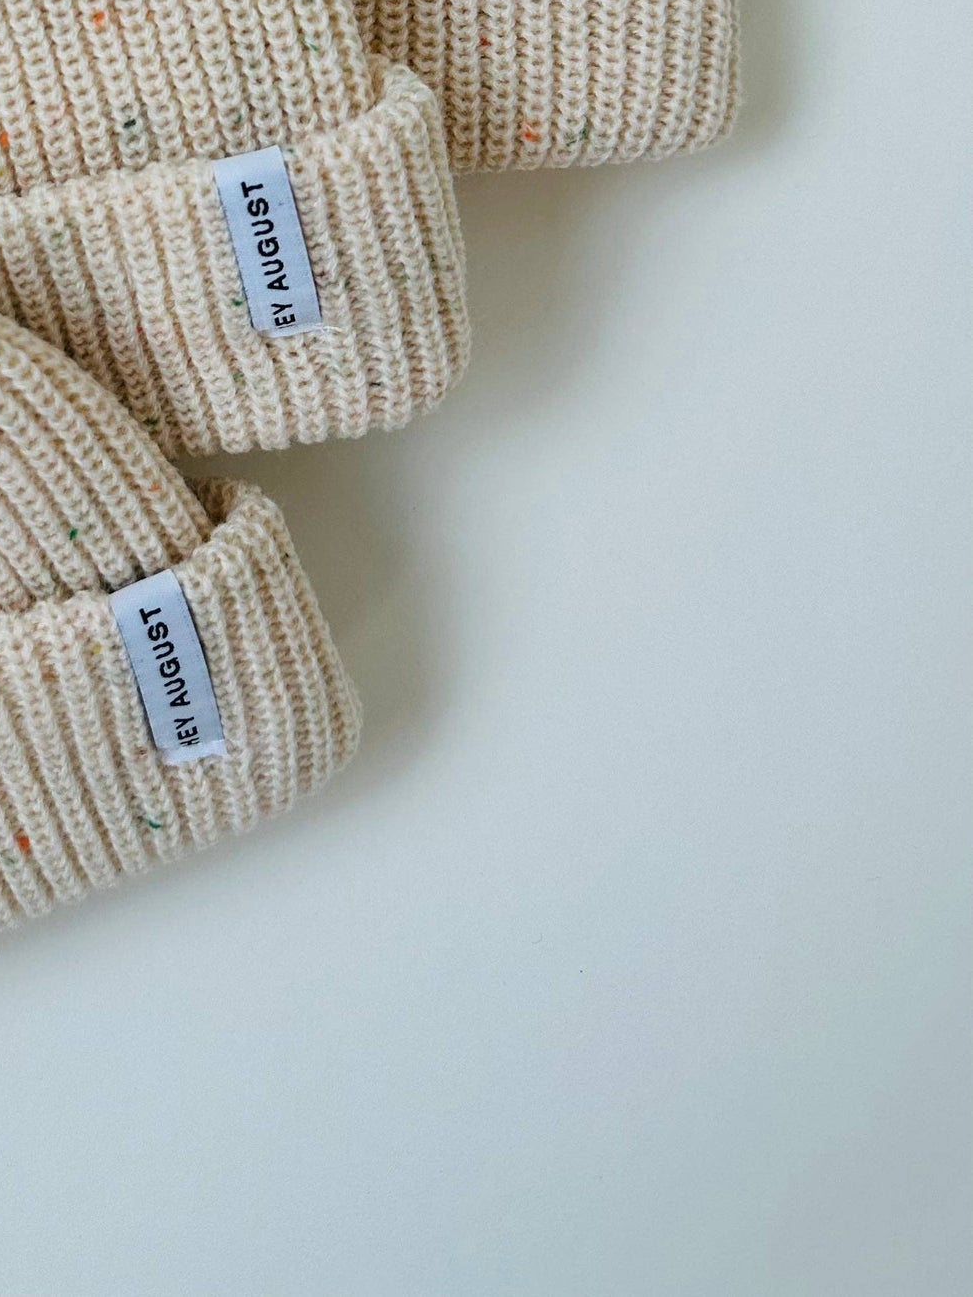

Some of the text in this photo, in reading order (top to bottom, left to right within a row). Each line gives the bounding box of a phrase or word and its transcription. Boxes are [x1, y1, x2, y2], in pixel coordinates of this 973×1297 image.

[240, 181, 297, 329] EY AUGUST
[139, 607, 191, 707] AUGUST
